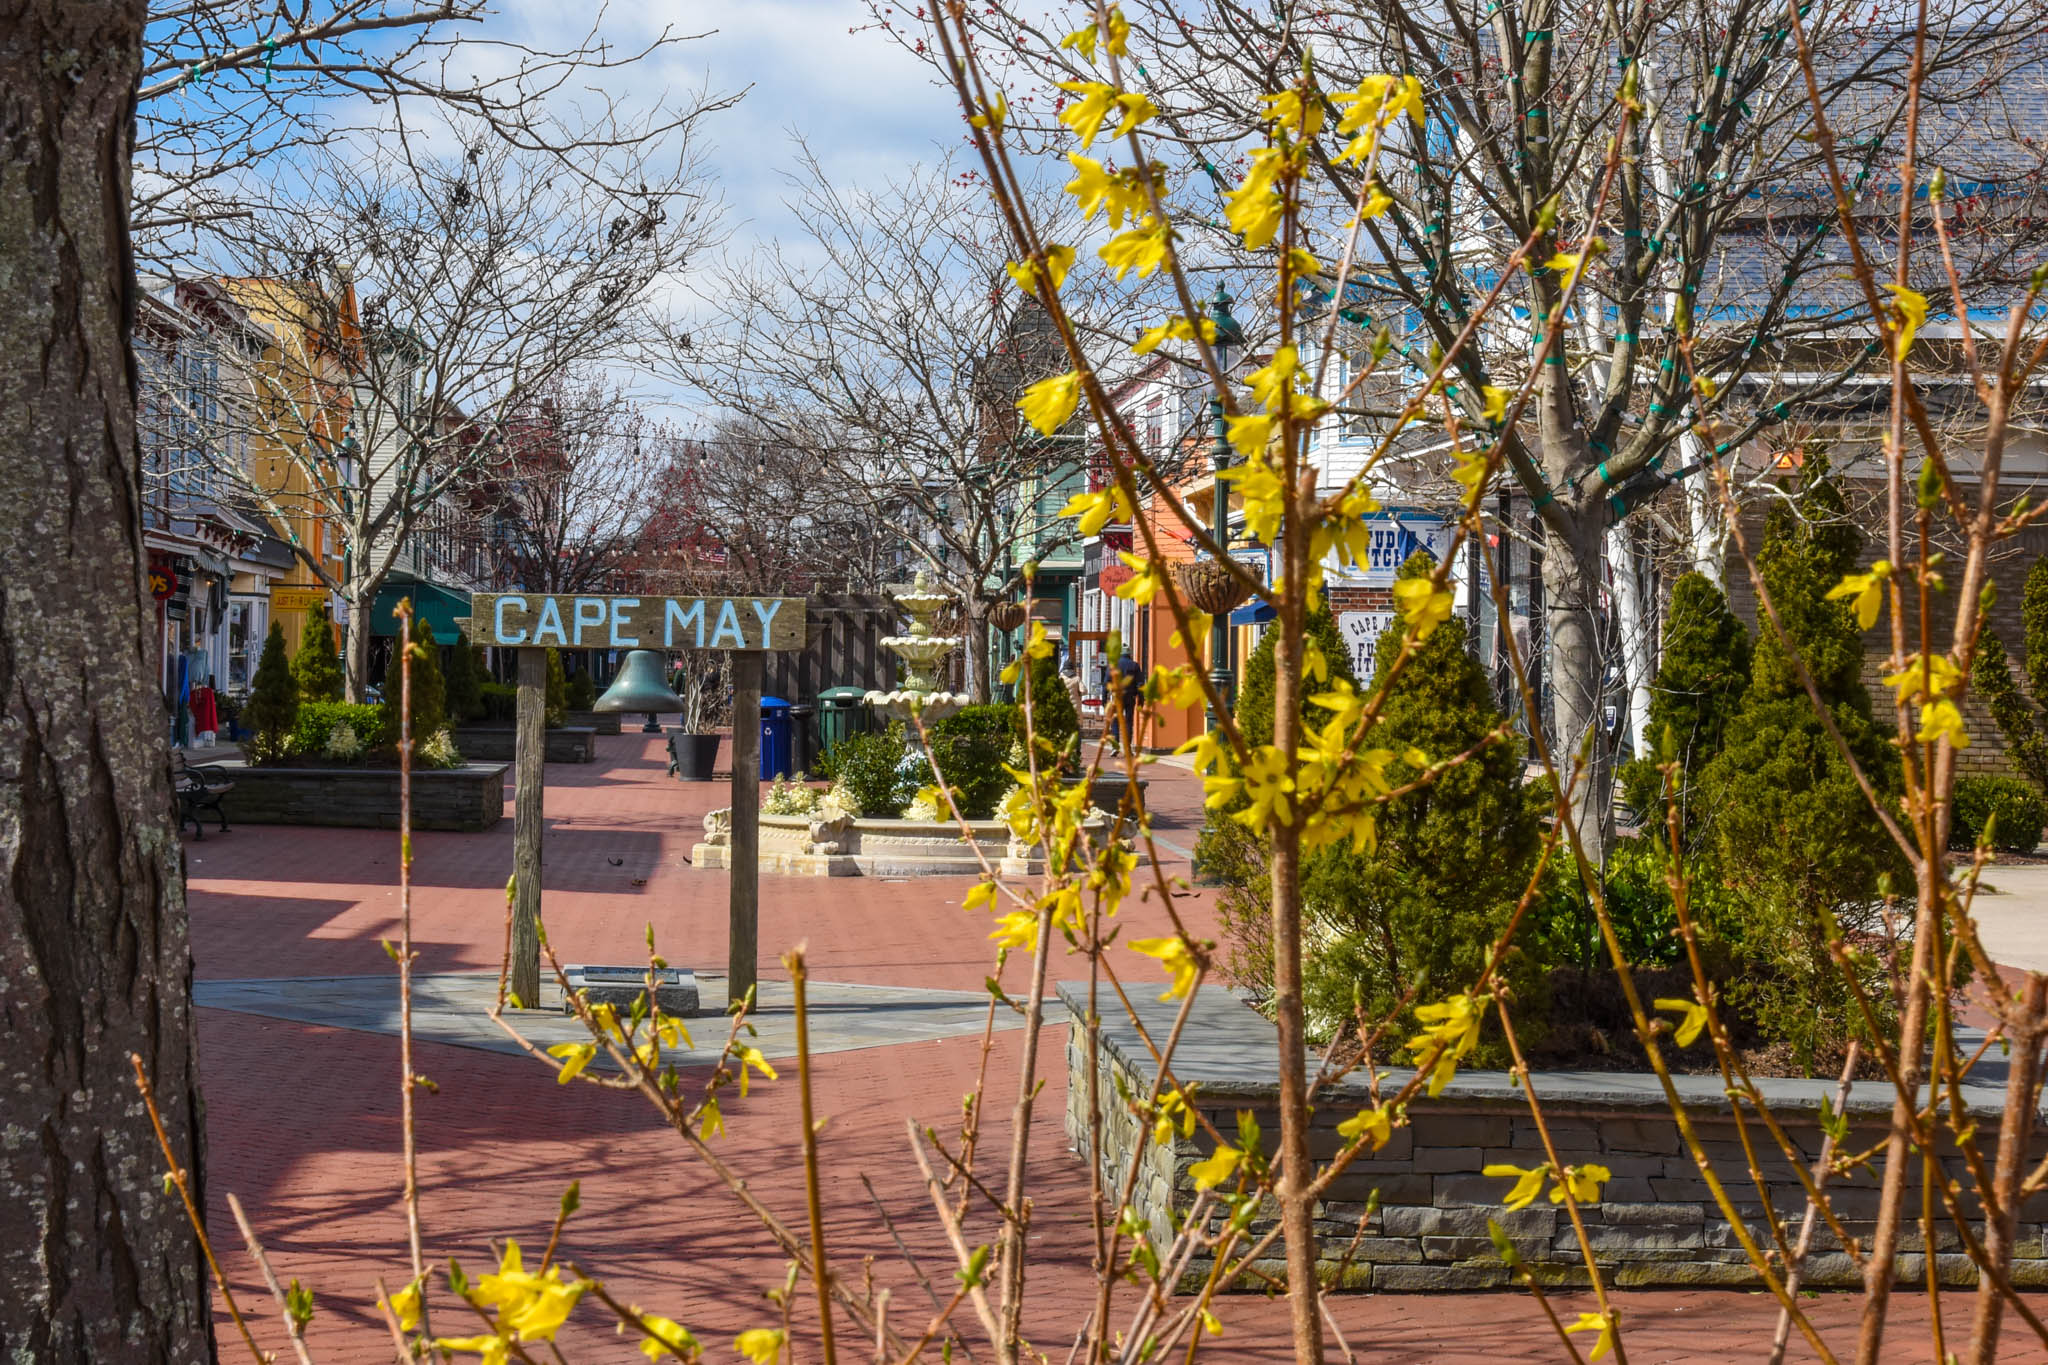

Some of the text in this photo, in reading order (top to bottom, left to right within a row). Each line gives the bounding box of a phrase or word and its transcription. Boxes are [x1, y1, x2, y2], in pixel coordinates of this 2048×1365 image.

[494, 596, 782, 649] CAPE MAY
[1350, 616, 1378, 636] CAPE
[1358, 643, 1376, 657] FU
